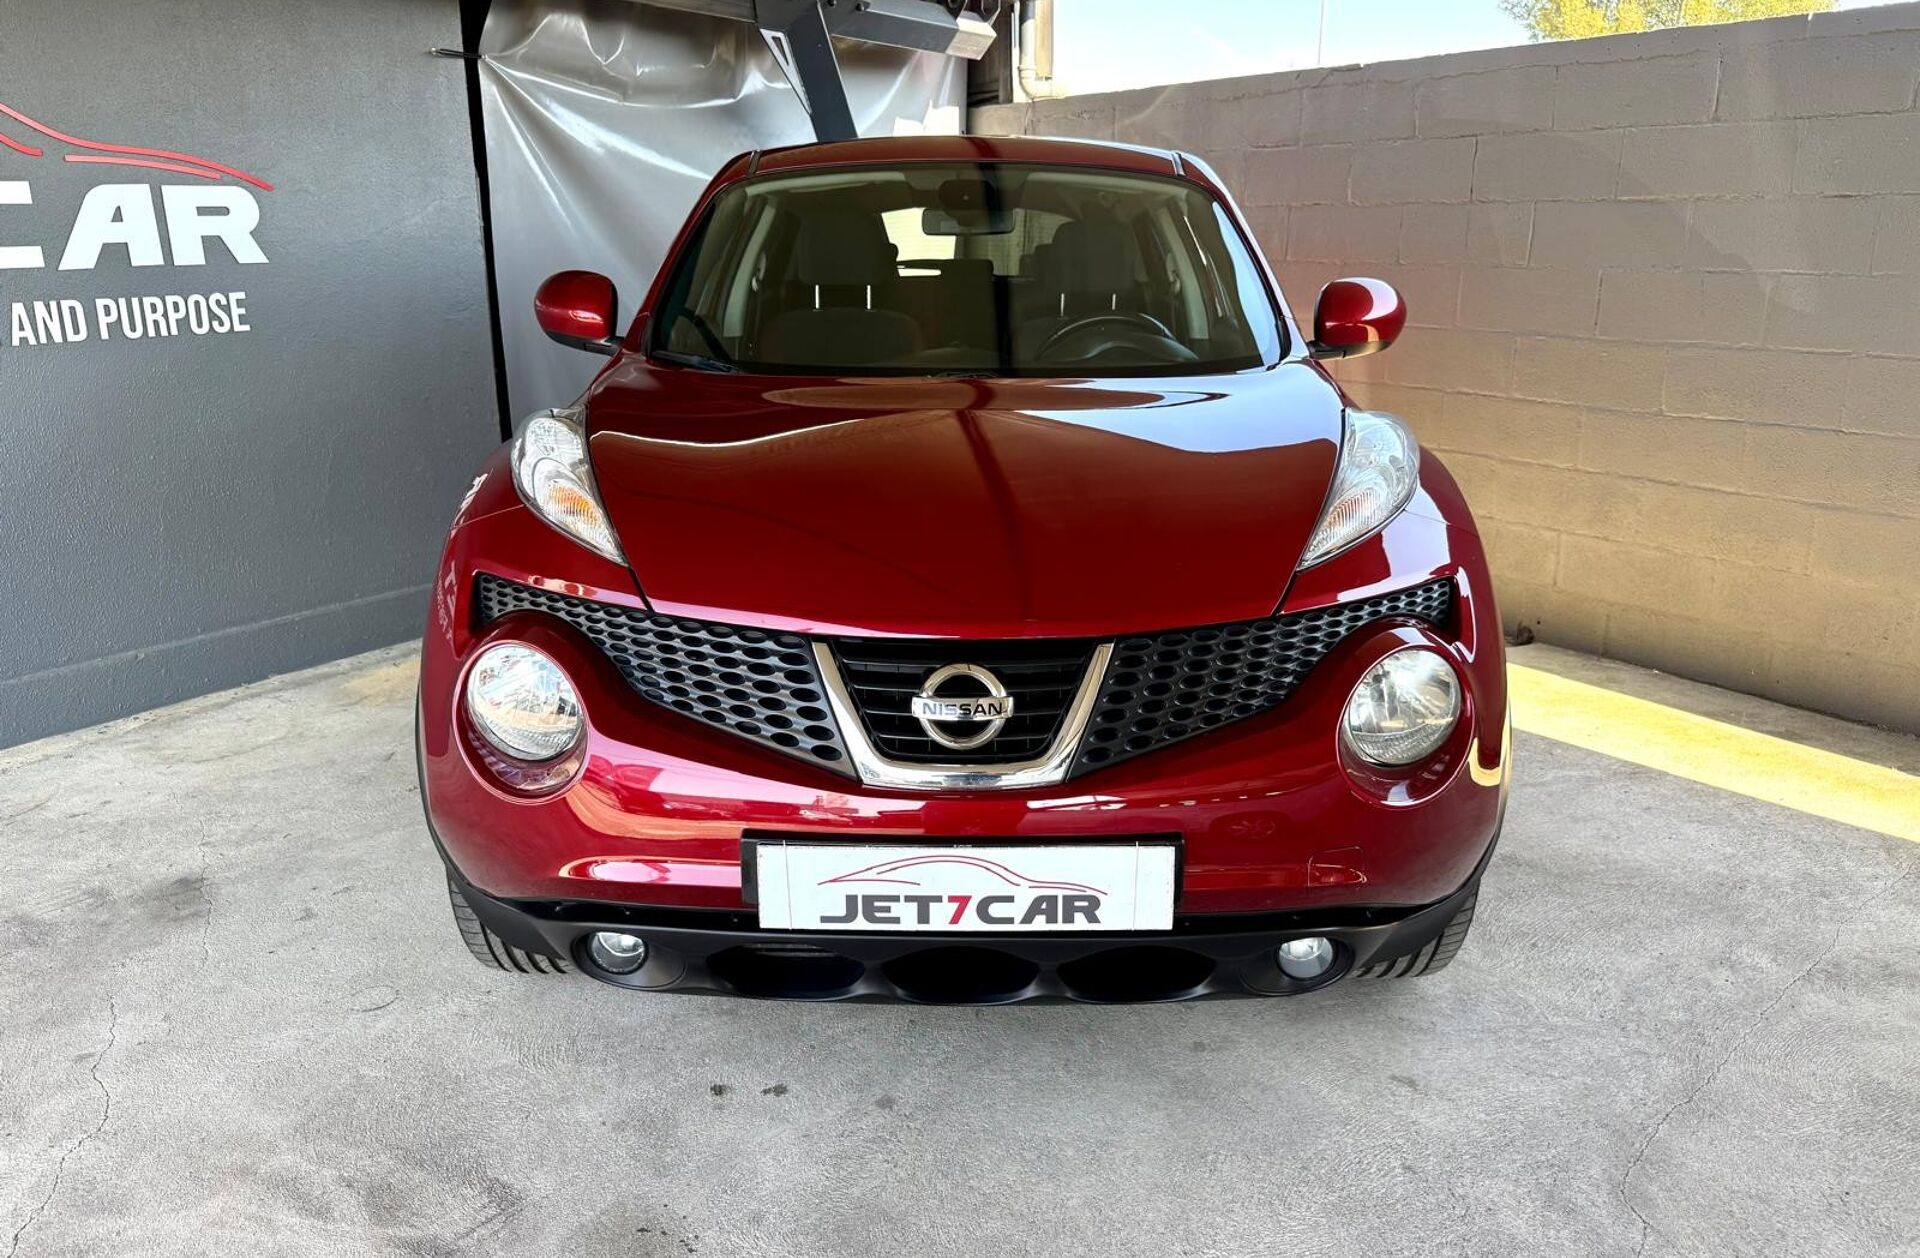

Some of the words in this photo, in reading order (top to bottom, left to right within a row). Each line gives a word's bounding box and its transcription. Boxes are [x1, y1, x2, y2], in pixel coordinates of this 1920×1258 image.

[11, 299, 88, 346] AND
[95, 291, 250, 340] PURPOSE
[922, 702, 1003, 716] NISSAN
[820, 894, 1101, 925] JET7CAR
